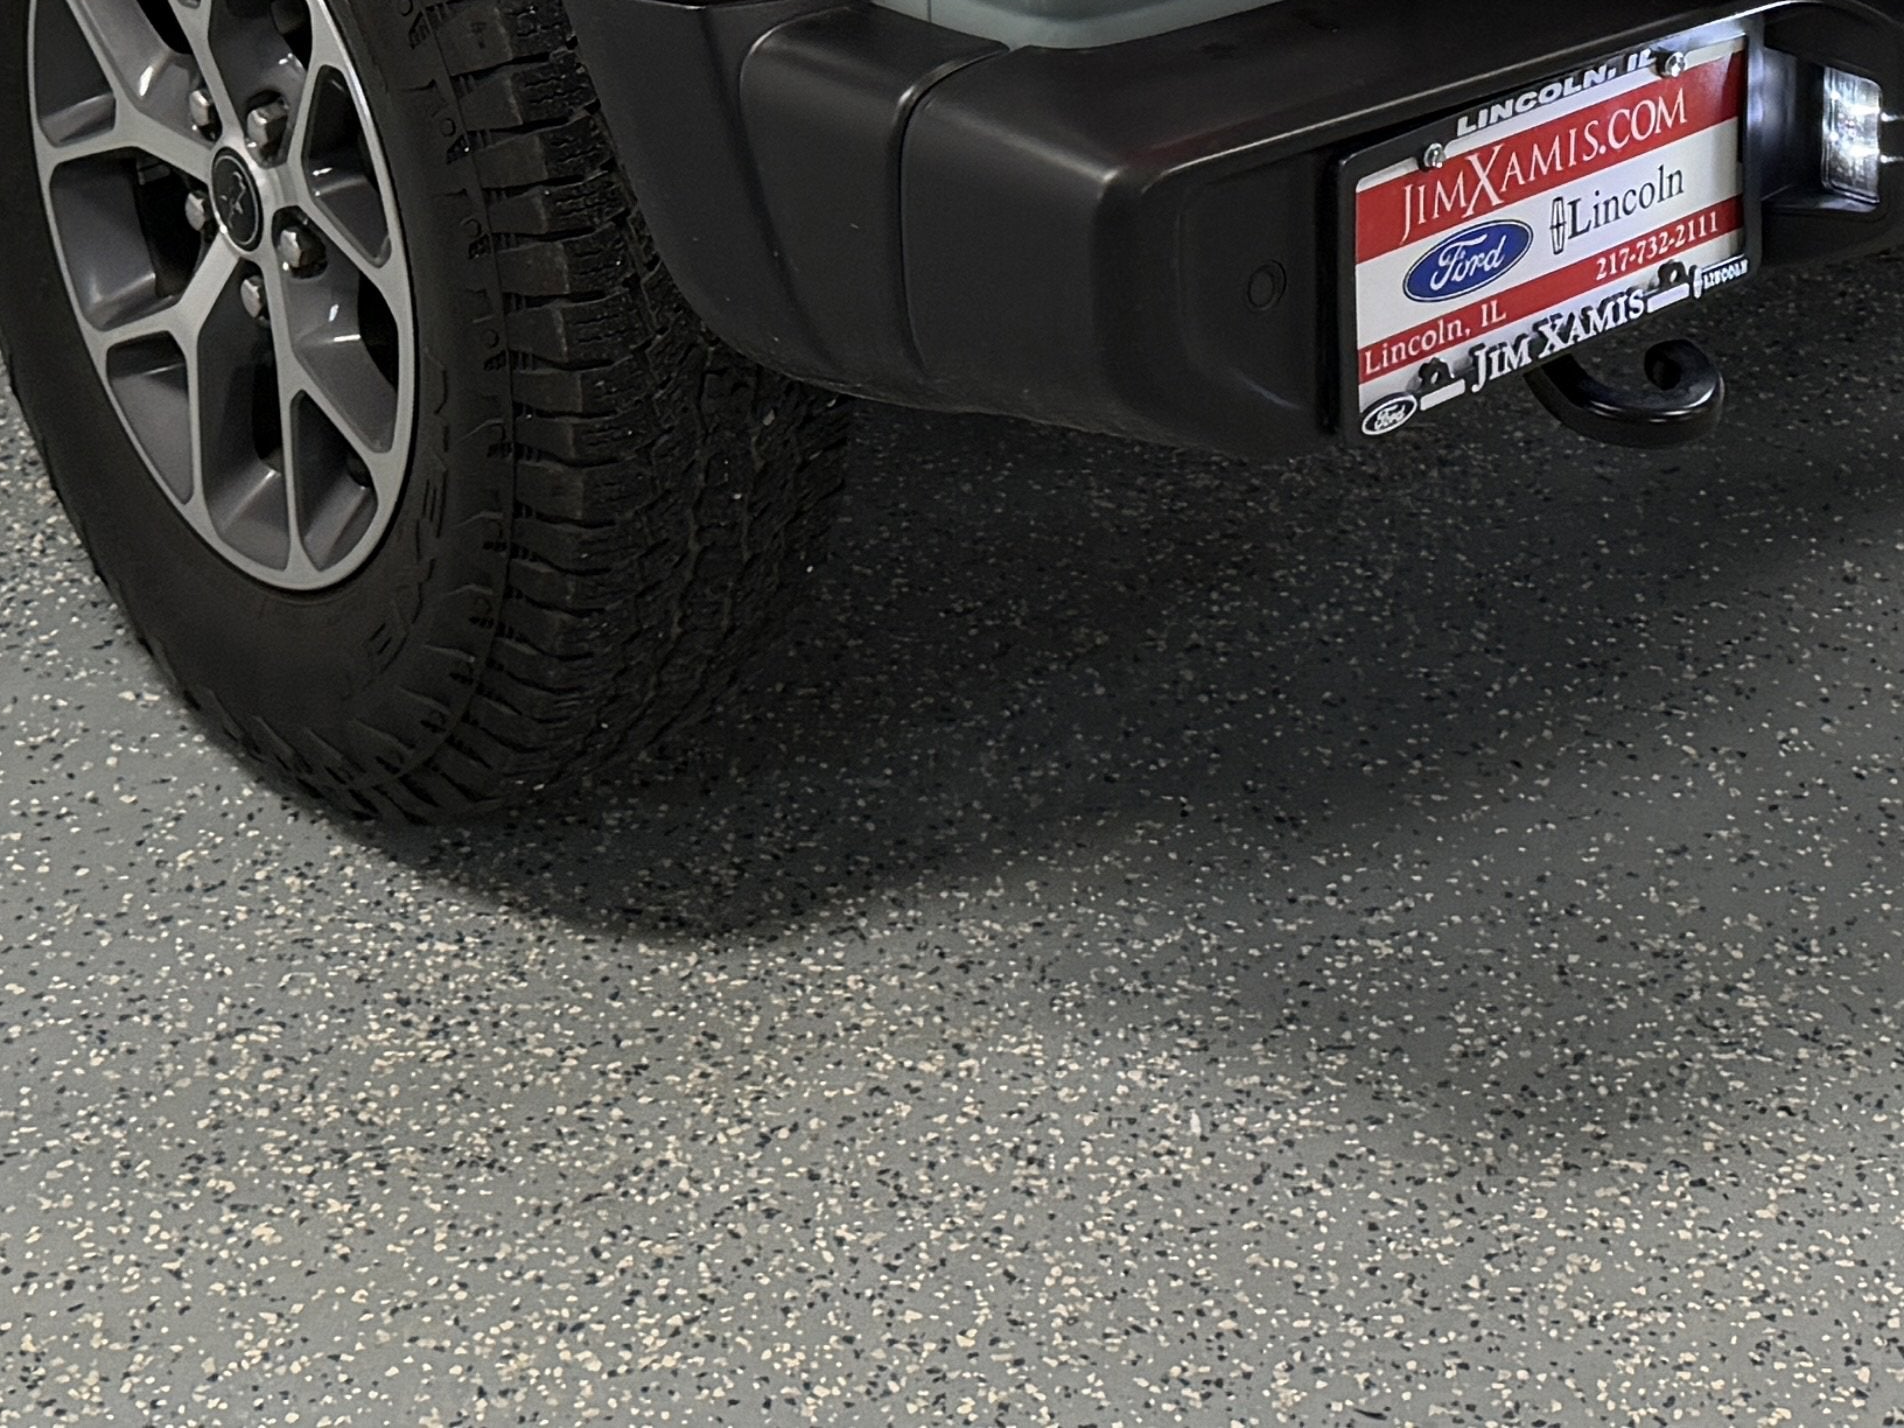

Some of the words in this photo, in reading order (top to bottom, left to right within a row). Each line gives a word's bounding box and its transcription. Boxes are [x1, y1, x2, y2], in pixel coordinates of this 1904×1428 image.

[1568, 164, 1684, 240] Lincoln
[1429, 233, 1508, 292] Ford
[1596, 211, 1719, 281] 217-732-2111
[1364, 320, 1472, 375] Lincoln,
[1480, 300, 1507, 328] IL
[1470, 339, 1534, 393] JIM
[1537, 288, 1646, 359] XAMIS
